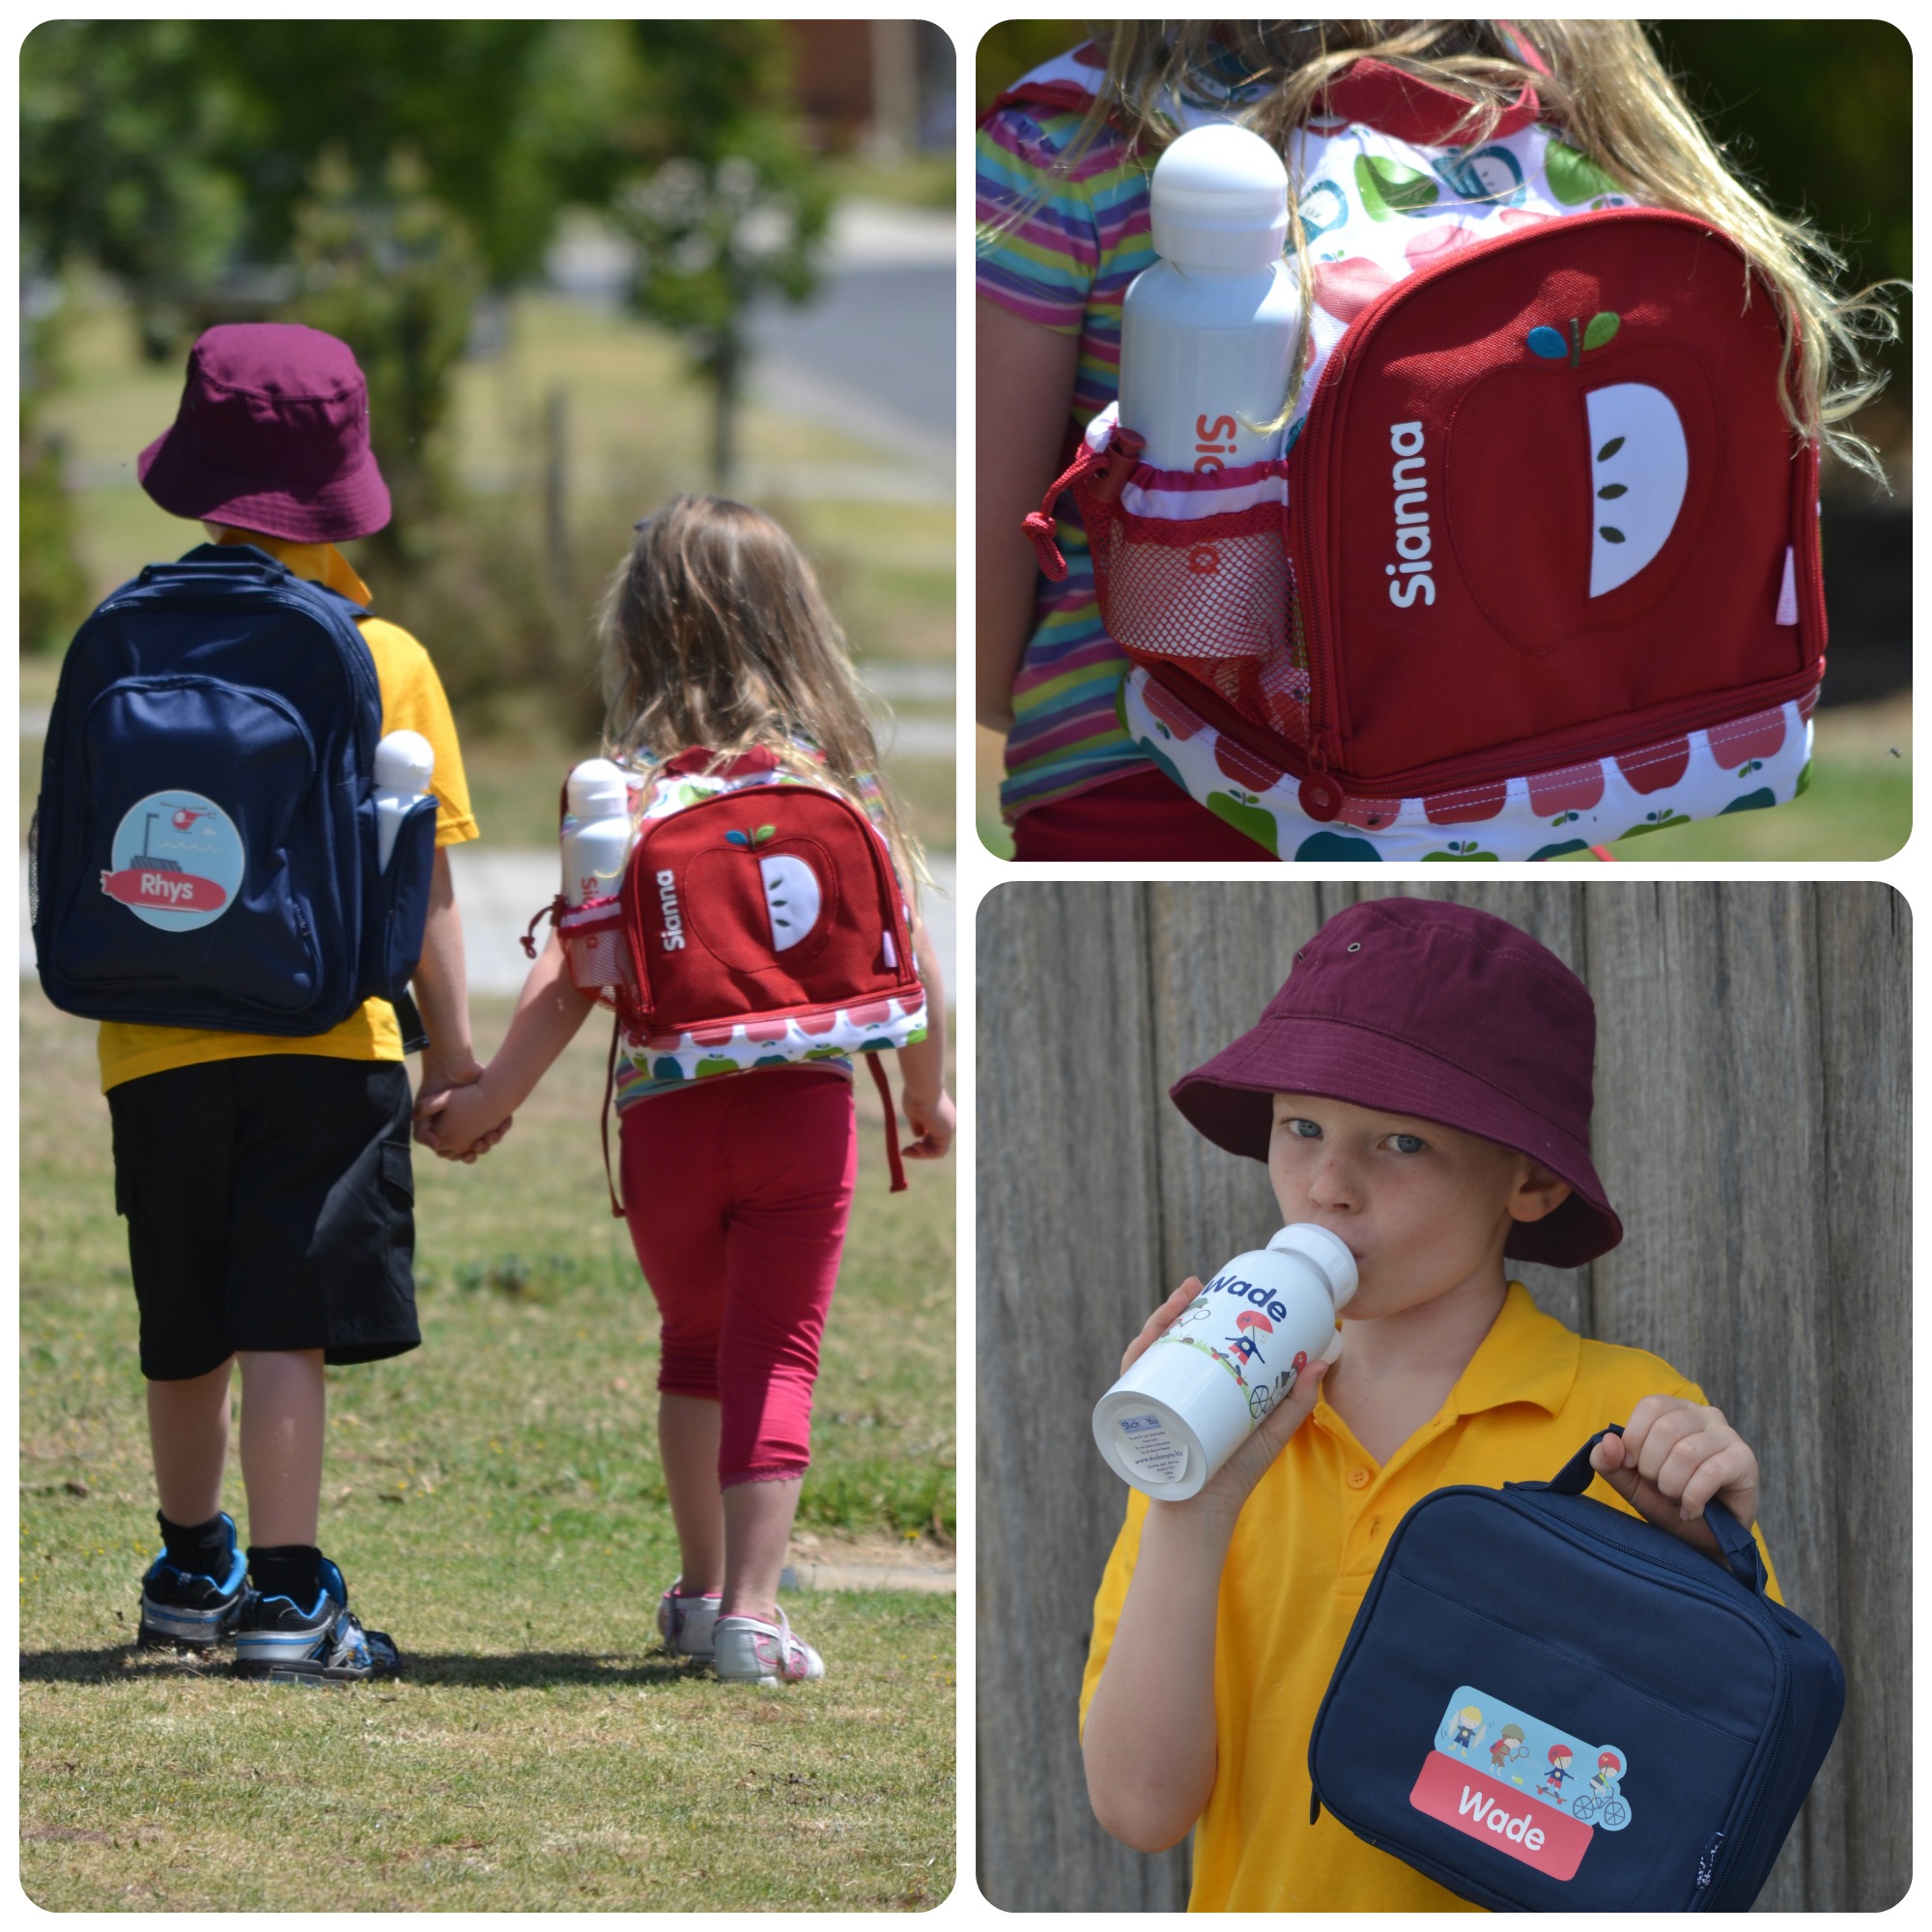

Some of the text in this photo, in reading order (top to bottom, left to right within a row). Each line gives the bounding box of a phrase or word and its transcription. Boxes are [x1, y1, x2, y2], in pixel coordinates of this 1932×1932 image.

[1385, 421, 1435, 609] Sianna
[140, 873, 193, 903] Rhys
[657, 869, 685, 952] Sianna
[1202, 1275, 1287, 1322] Wade
[1134, 1451, 1183, 1464] www.stuckonyou.biz
[1459, 1785, 1545, 1851] Wade
